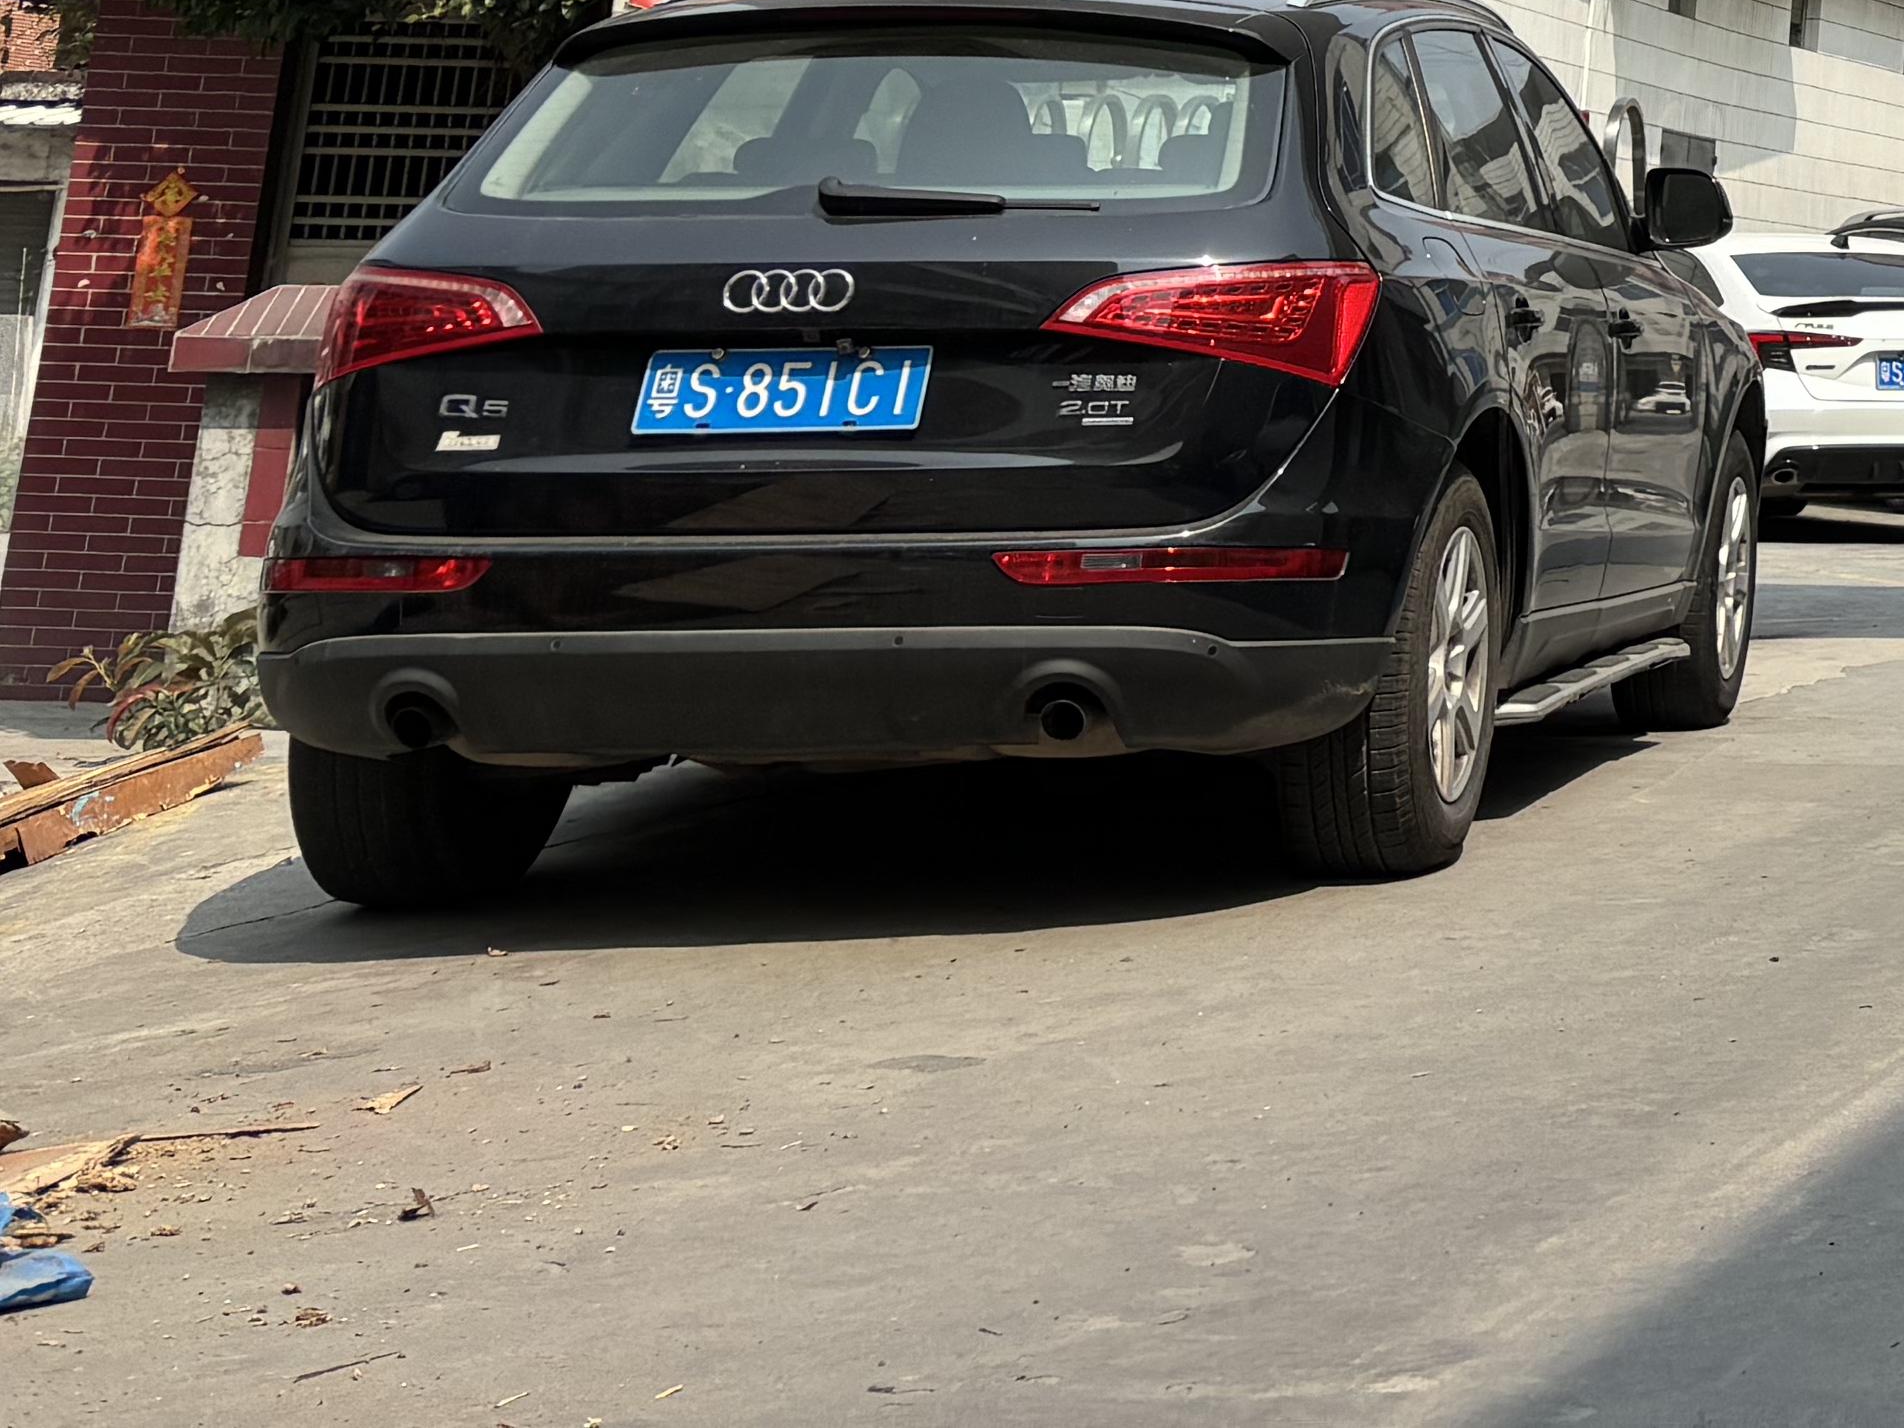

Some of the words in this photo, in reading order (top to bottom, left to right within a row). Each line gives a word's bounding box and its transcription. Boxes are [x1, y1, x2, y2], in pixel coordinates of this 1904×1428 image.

[1052, 374, 1137, 392] 一汽奥迪
[439, 394, 509, 418] Q5
[1058, 400, 1130, 416] 2.0T
